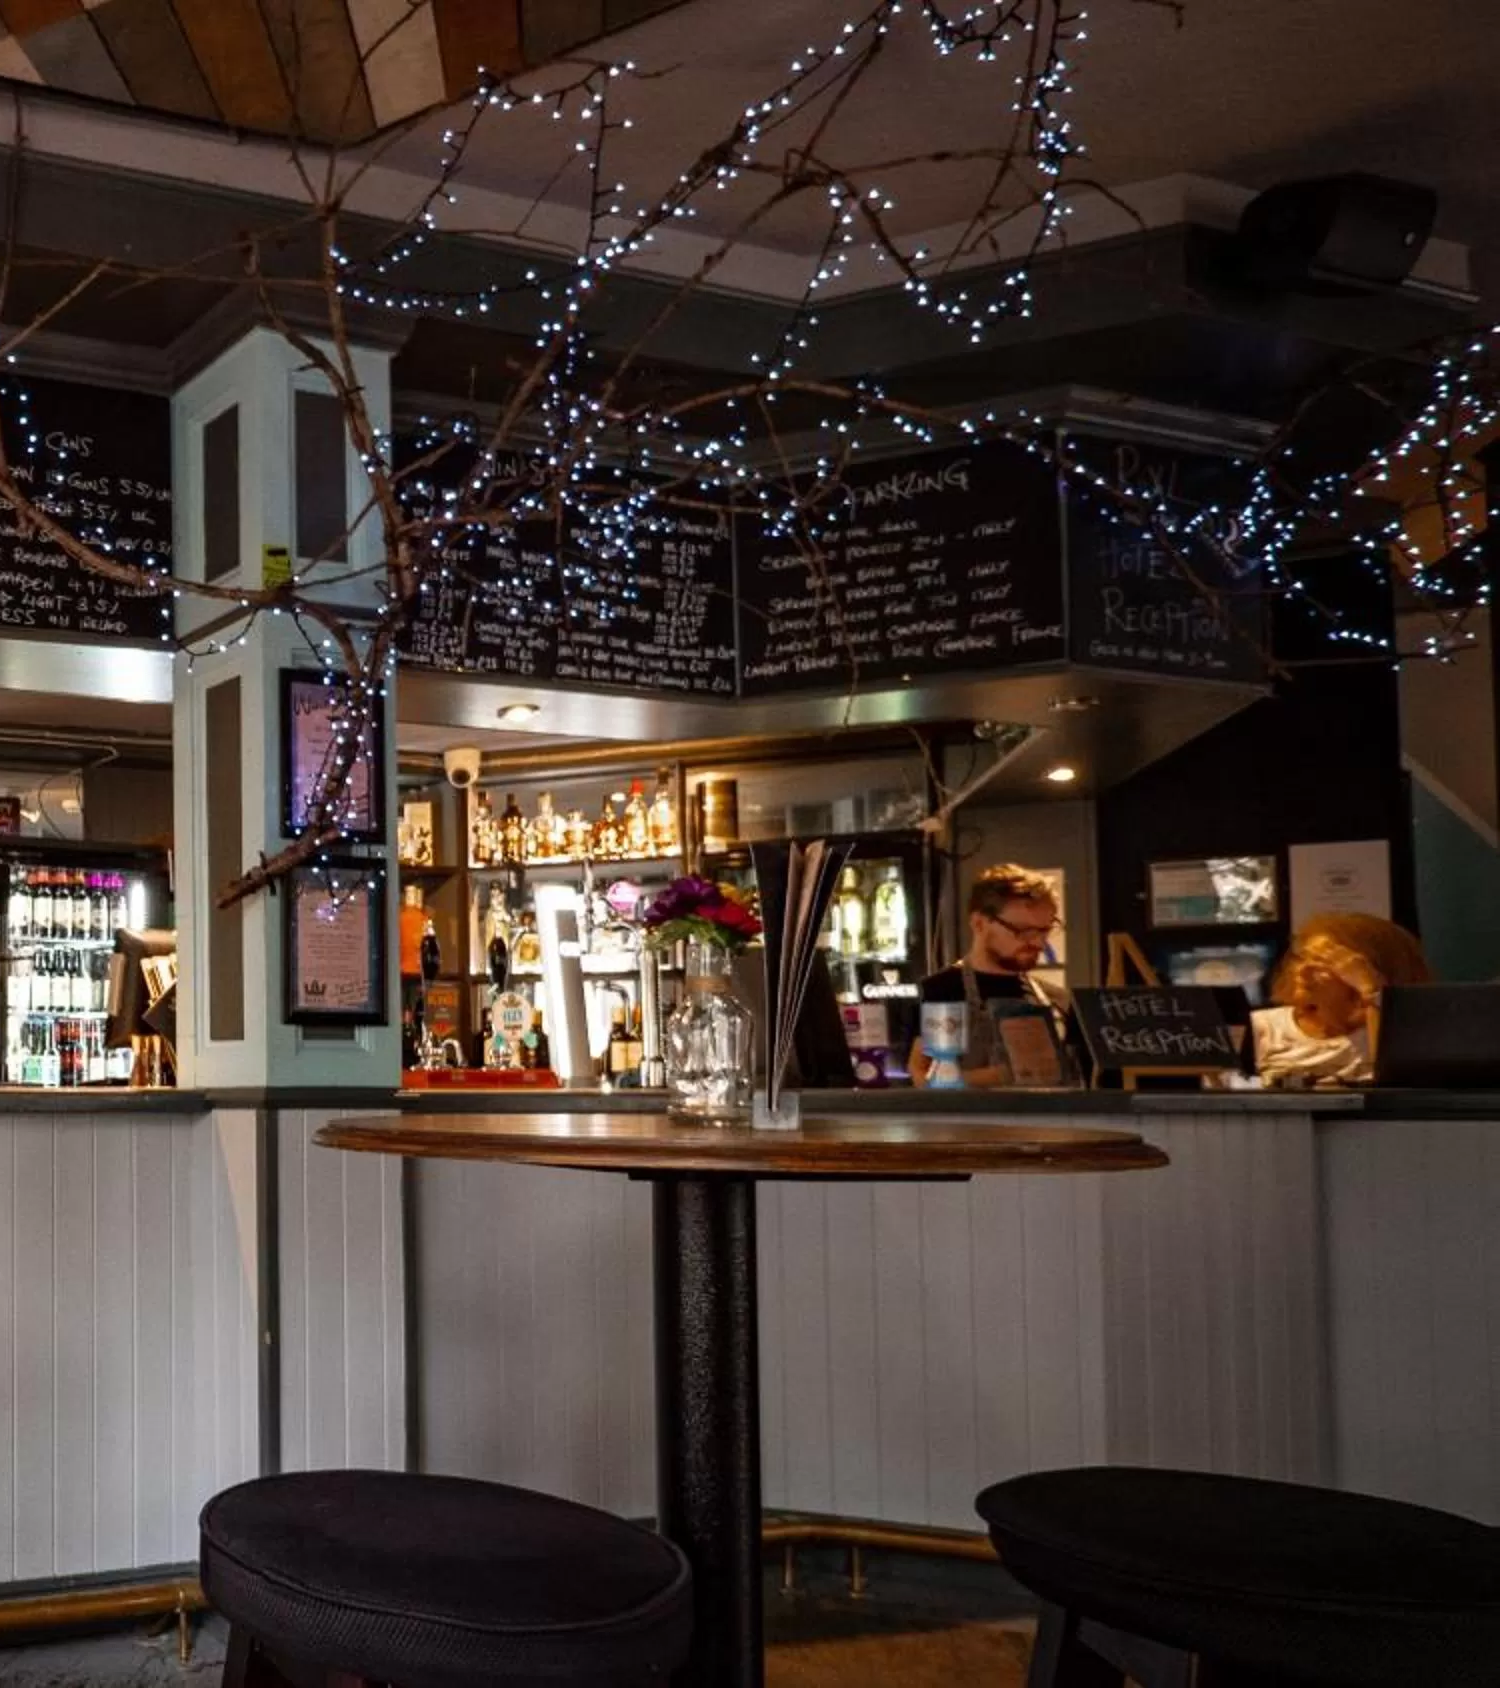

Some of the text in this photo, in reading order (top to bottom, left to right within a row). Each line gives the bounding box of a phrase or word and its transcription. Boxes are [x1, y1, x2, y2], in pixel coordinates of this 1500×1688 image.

[45, 431, 94, 458] CANS
[1099, 991, 1195, 1021] HOTEL
[1099, 1023, 1231, 1056] RECEPTION
